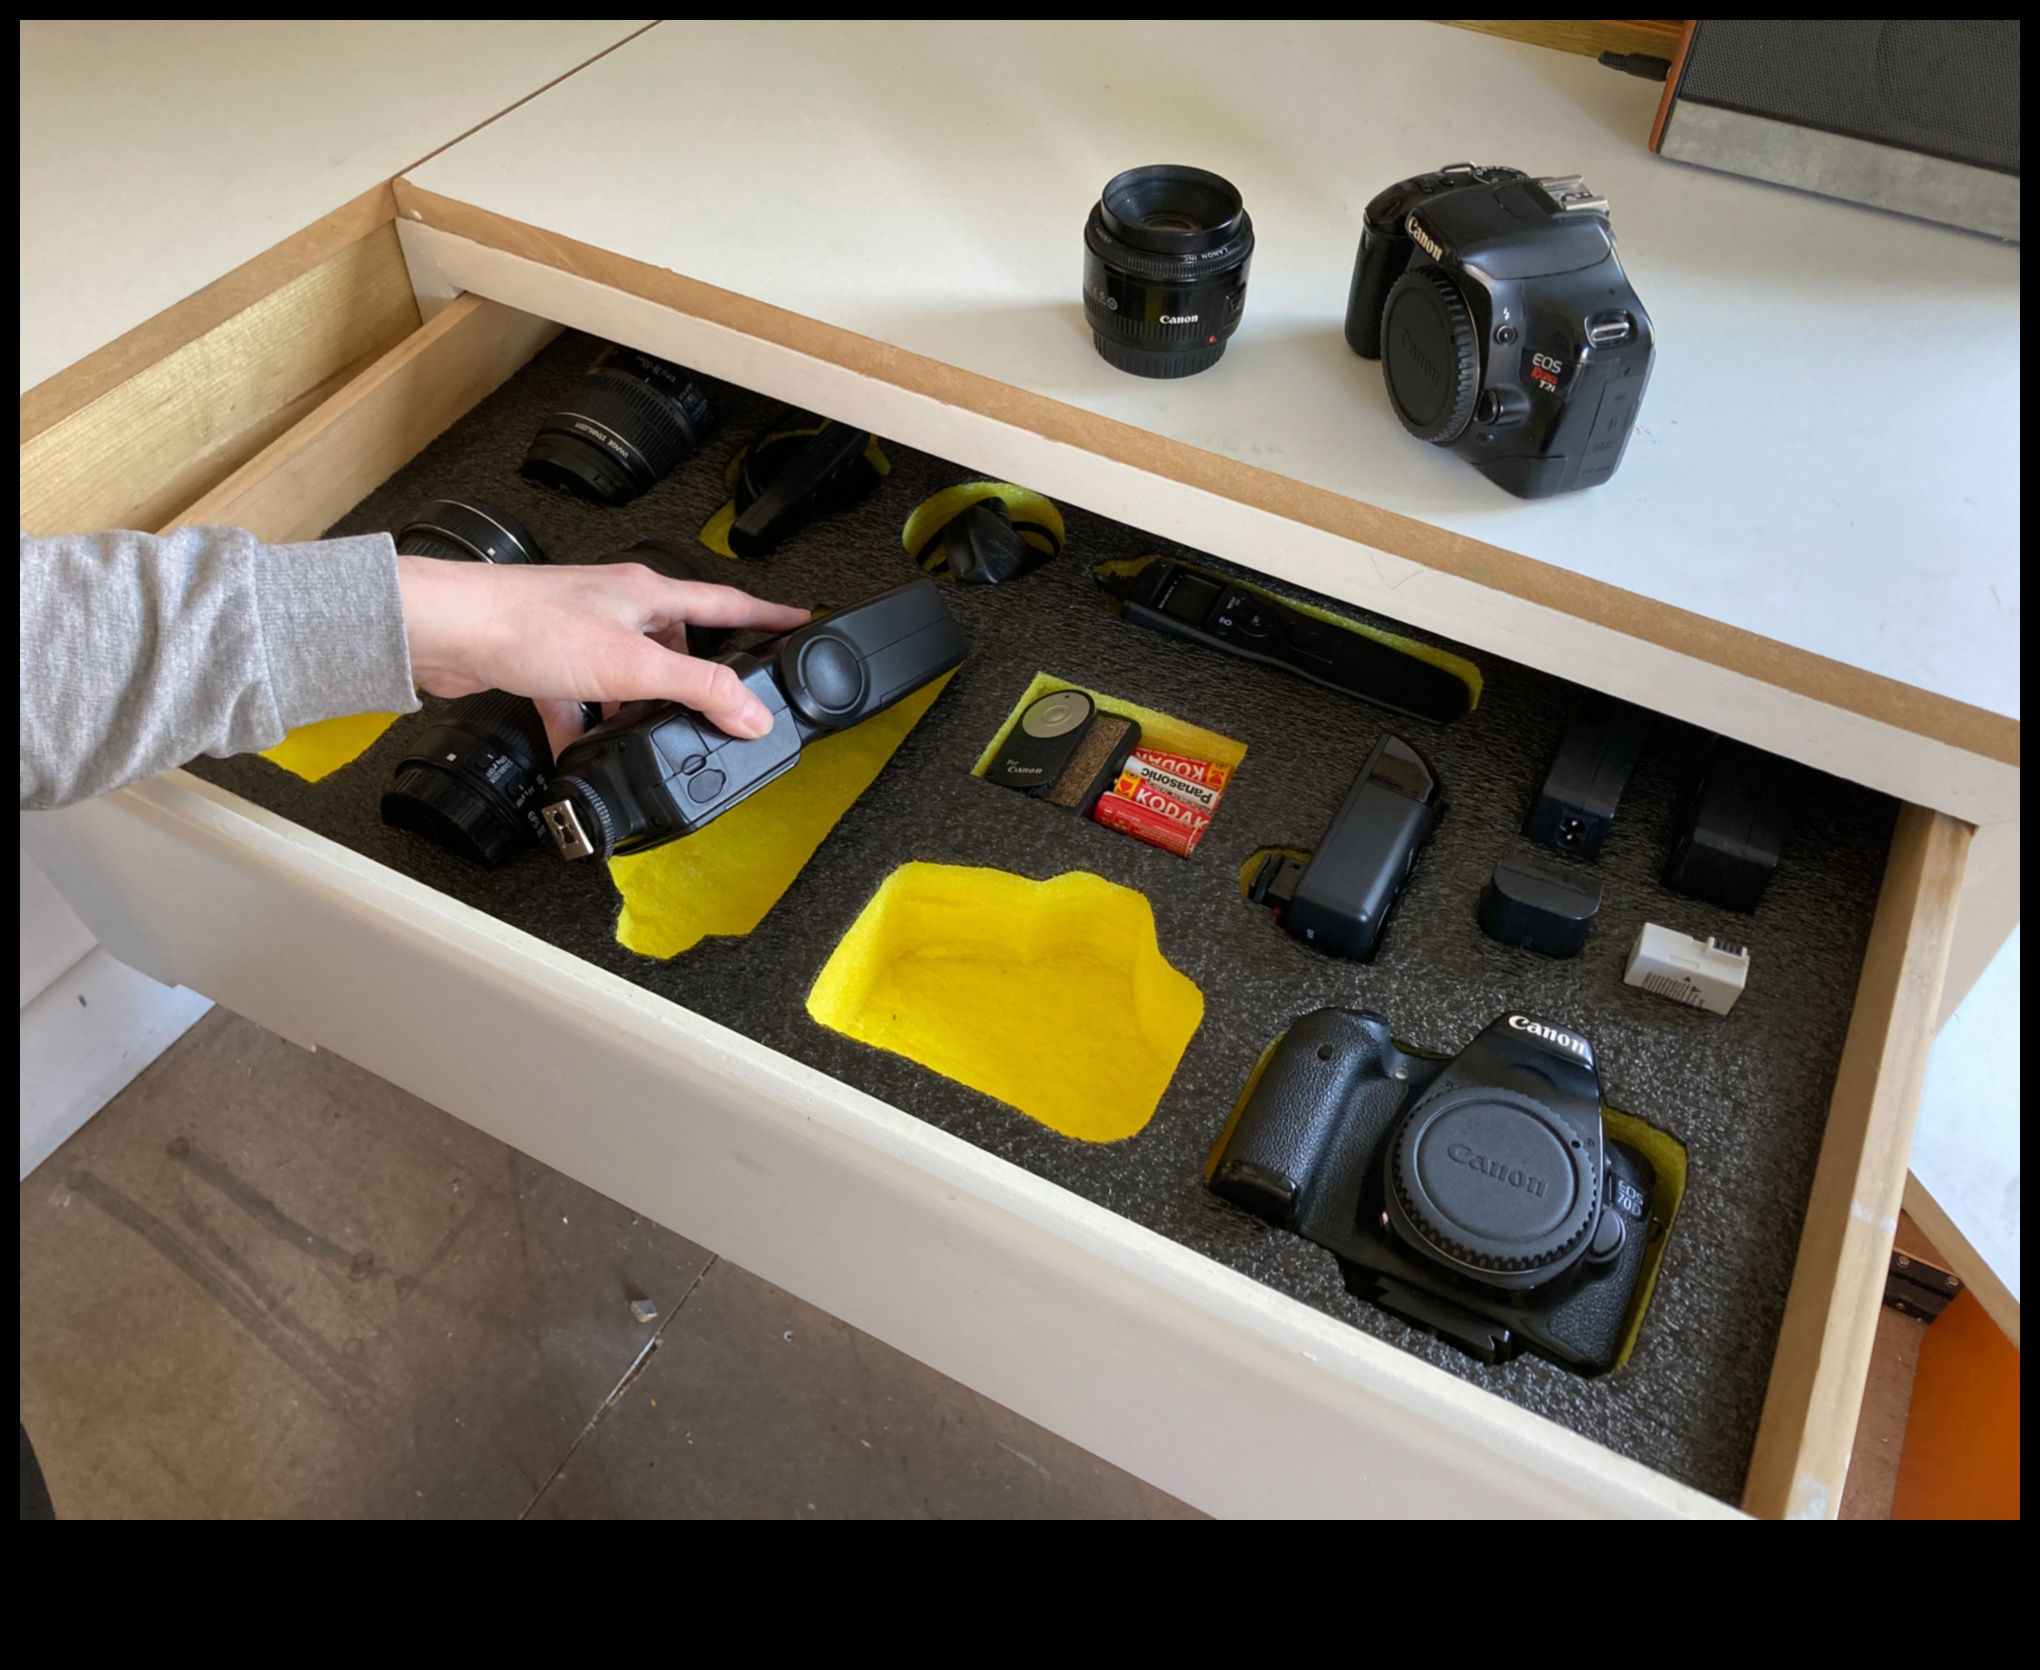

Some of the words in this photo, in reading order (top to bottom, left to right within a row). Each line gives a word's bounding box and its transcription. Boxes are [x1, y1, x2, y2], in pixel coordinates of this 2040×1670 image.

[1406, 216, 1443, 262] Canon
[1201, 246, 1229, 260] CANON
[1159, 314, 1199, 325] Canon
[1532, 352, 1563, 374] EOS
[1539, 379, 1556, 393] T2i
[574, 421, 608, 442] STABILIZER
[607, 438, 630, 459] IMAGE
[489, 760, 514, 784] STABILIZER
[1007, 765, 1043, 775] Canon
[1141, 767, 1213, 804] Panasonic
[1136, 787, 1210, 829] KODAK
[1508, 1014, 1588, 1056] Canon
[1447, 1142, 1550, 1198] Canon
[1617, 1192, 1641, 1216] 70D
[1619, 1180, 1643, 1205] EOS
